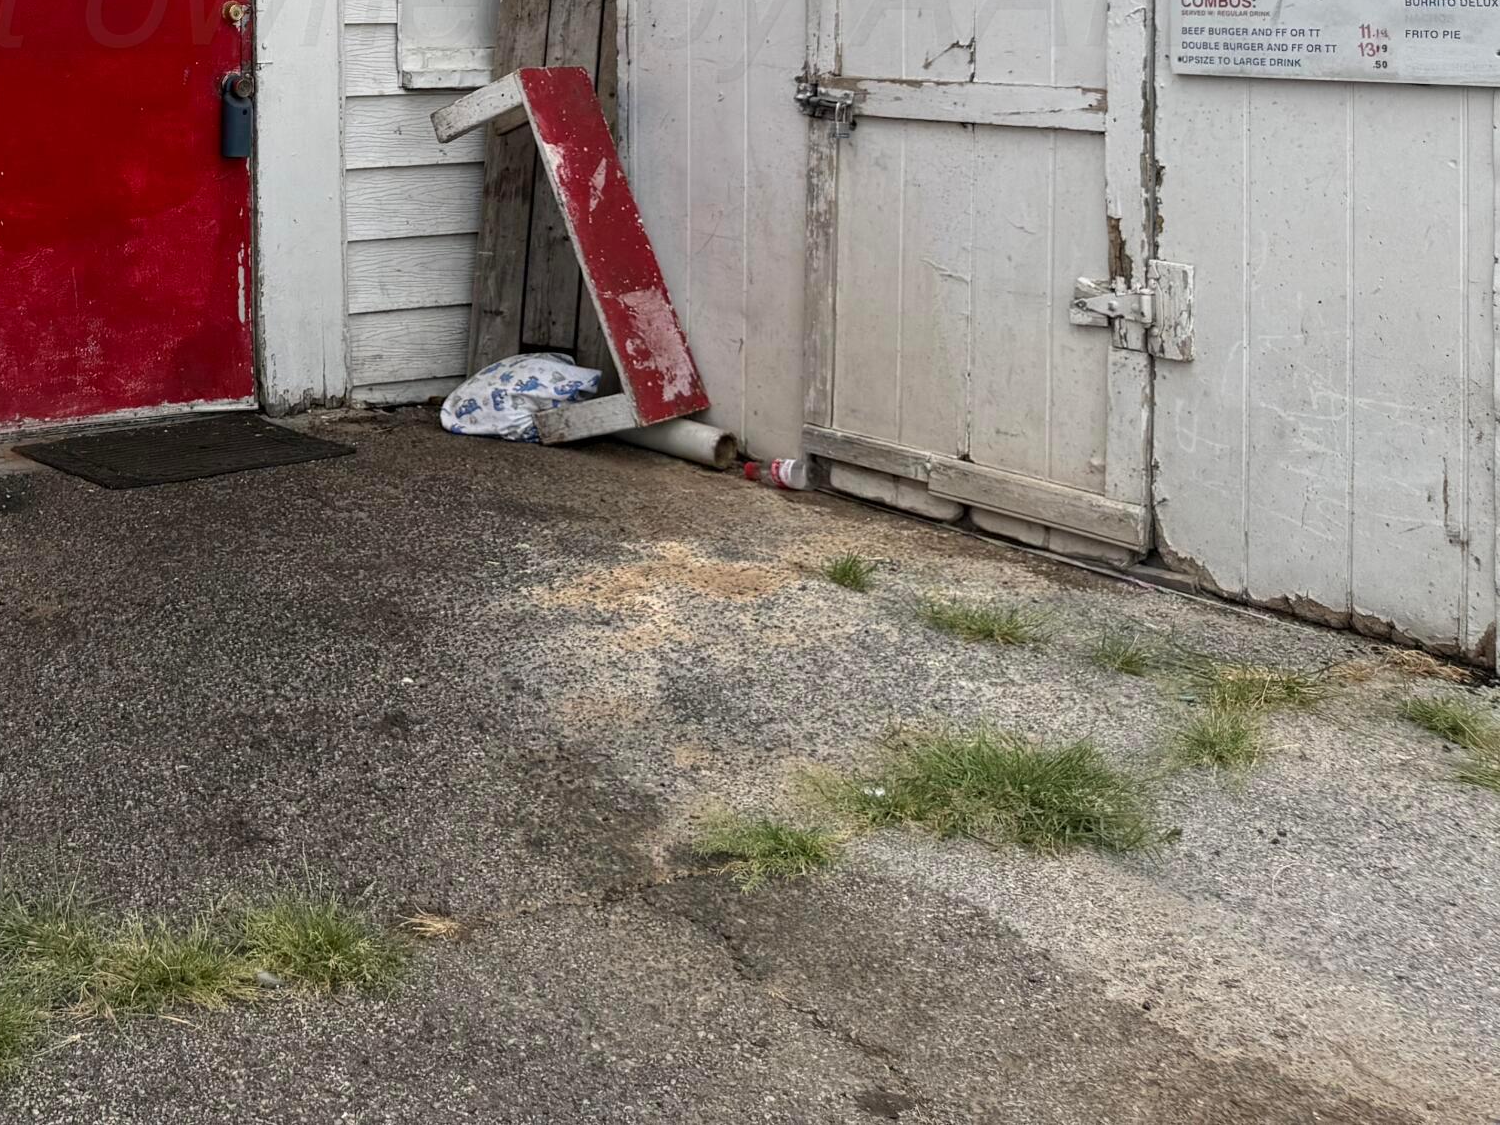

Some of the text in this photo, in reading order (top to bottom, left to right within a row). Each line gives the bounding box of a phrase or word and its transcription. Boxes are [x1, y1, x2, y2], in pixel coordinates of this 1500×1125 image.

[1182, 27, 1321, 37] BEEF BURGER AND FF OR TT
[1405, 30, 1461, 39] FRITO PIE
[1182, 42, 1337, 53] DOUBLE BURGER AND FF OR TT
[1234, 58, 1266, 66] LARGE
[1269, 58, 1301, 67] DRINK
